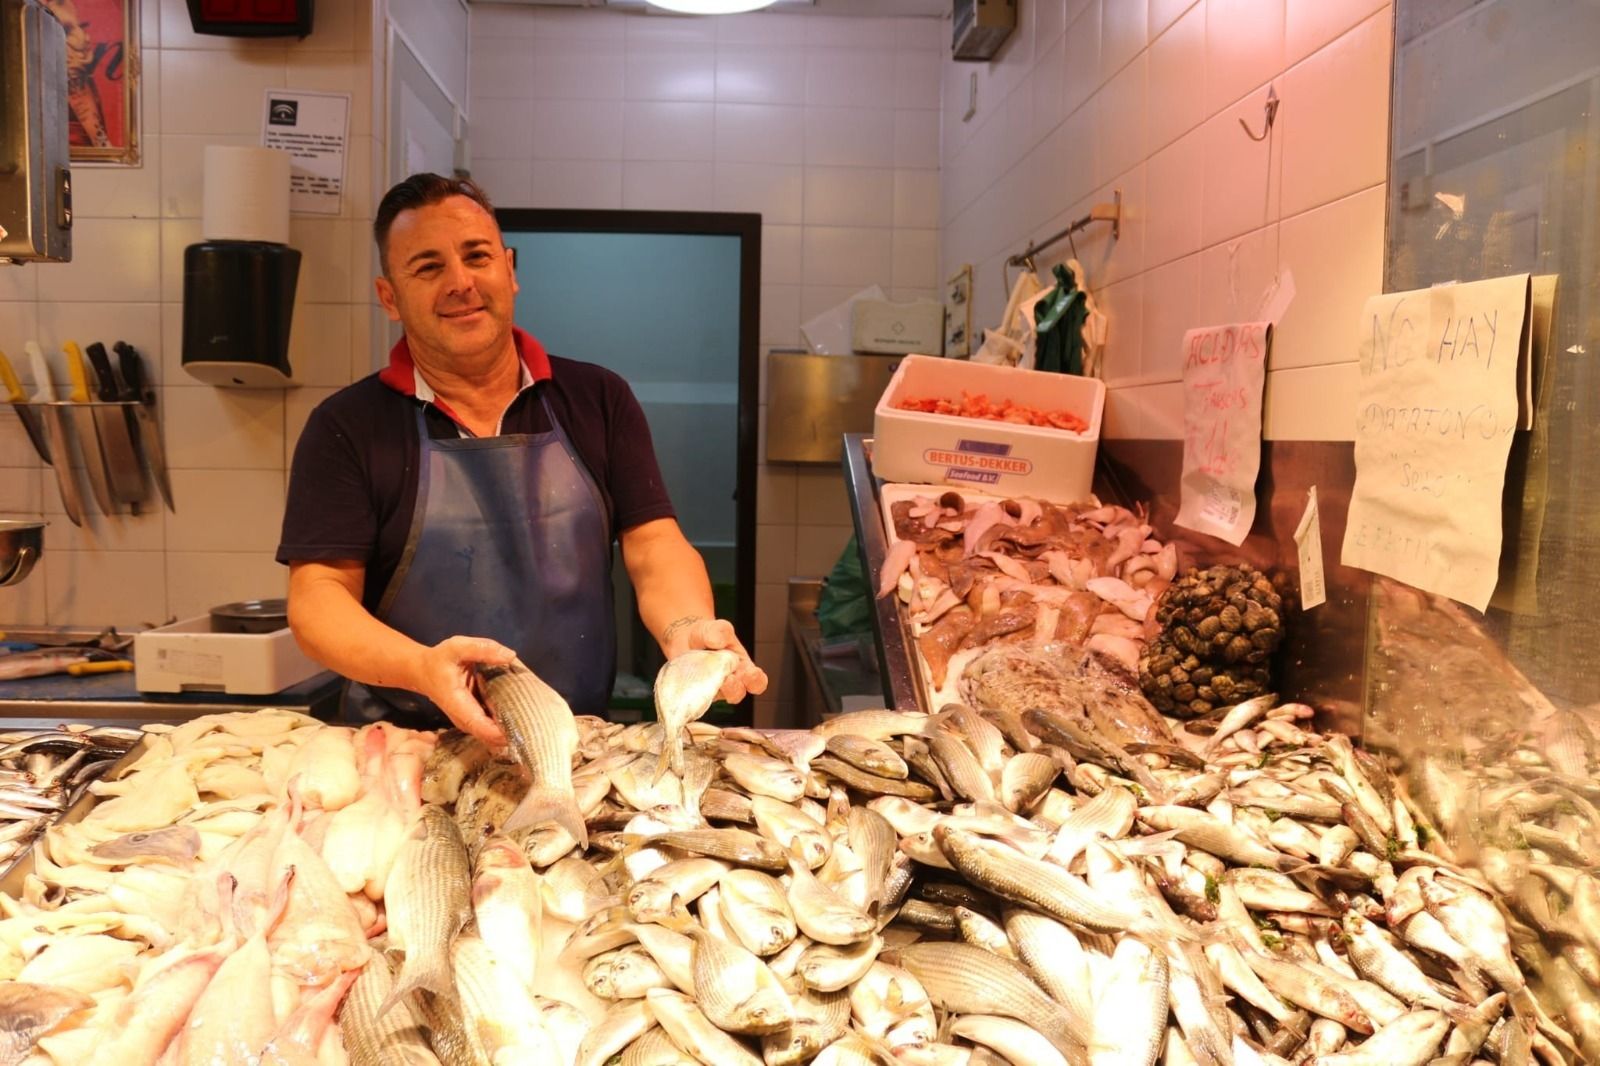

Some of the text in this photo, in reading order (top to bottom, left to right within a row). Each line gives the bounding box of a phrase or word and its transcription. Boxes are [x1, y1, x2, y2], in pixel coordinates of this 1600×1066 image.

[1369, 298, 1498, 375] NO HAY
[930, 452, 1027, 472] BERTUS-DEKKER
